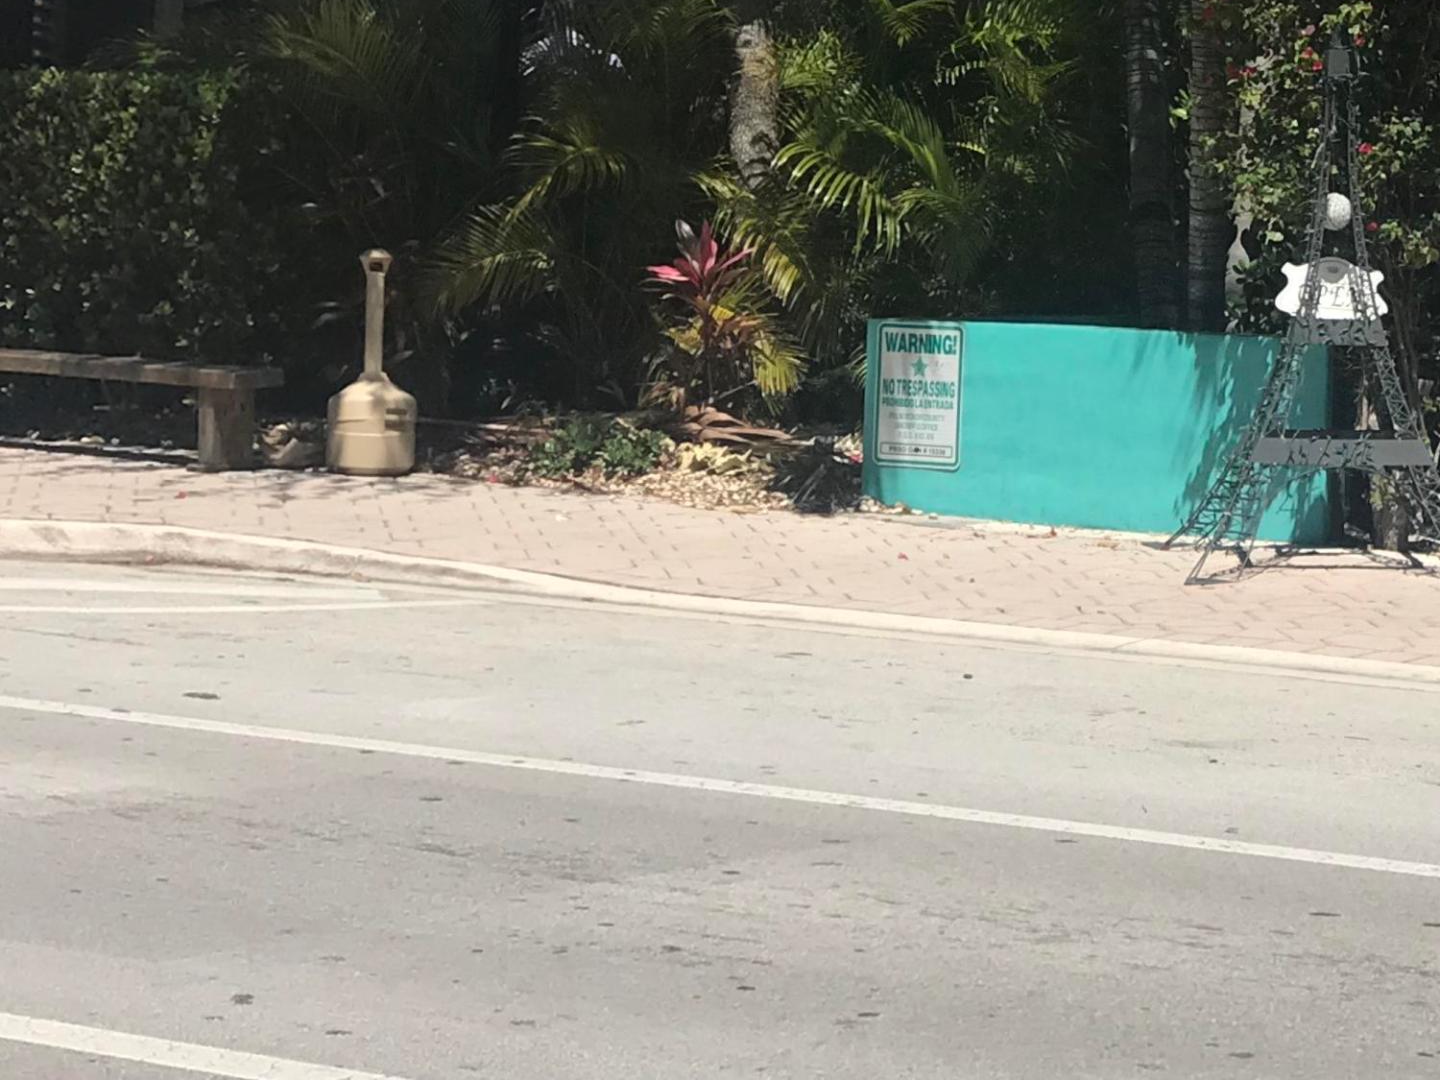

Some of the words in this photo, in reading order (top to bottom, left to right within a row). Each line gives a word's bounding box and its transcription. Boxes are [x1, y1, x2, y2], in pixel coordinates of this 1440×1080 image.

[885, 332, 957, 355] WARNING!
[882, 378, 896, 396] NO
[897, 379, 955, 399] TRESPASSING
